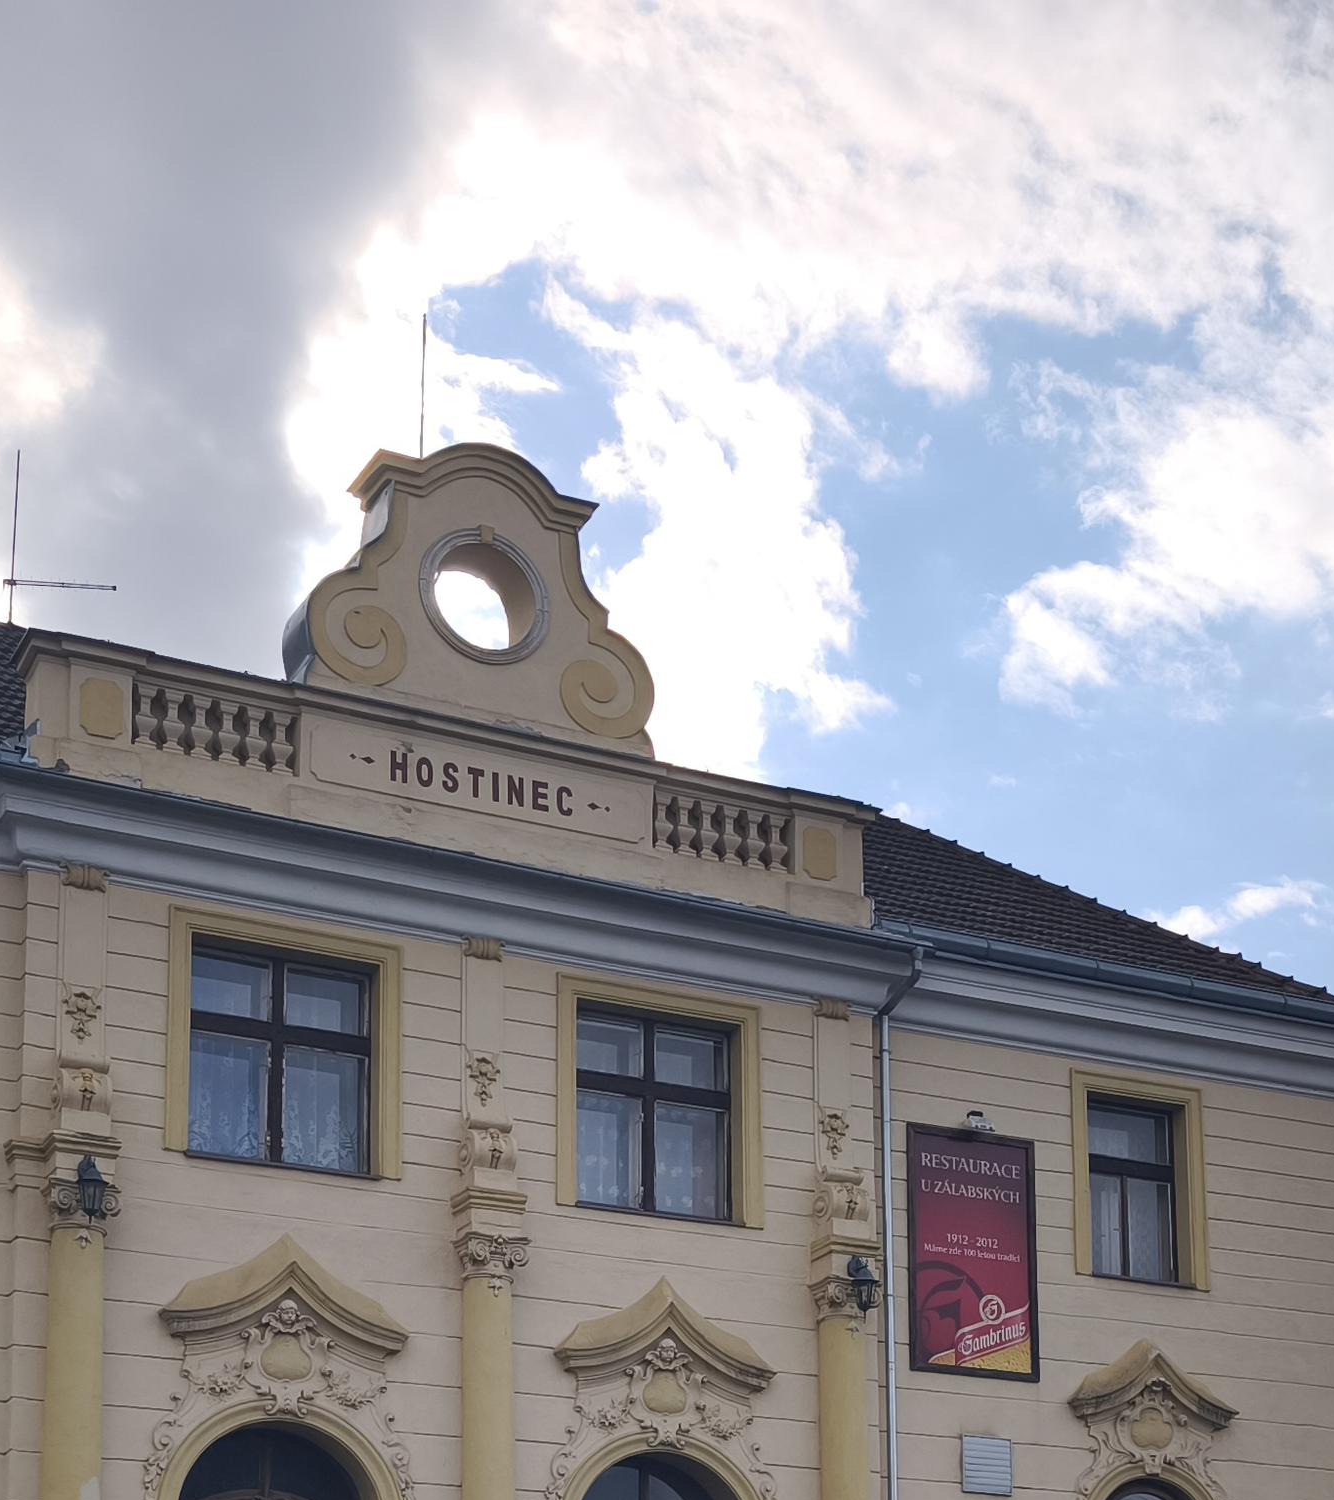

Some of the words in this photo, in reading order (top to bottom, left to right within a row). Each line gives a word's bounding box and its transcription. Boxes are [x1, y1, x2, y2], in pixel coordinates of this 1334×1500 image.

[389, 749, 574, 817] HOSTINEC
[921, 1152, 1021, 1179] RESTAURACE
[921, 1179, 931, 1192] U
[934, 1178, 1020, 1203] ZÁLABSKÝCH
[946, 1233, 969, 1245] 1912
[975, 1237, 999, 1249] 2012
[949, 1246, 963, 1256] zde
[963, 1248, 977, 1257] 100
[958, 1321, 1026, 1355] Gambrinus
